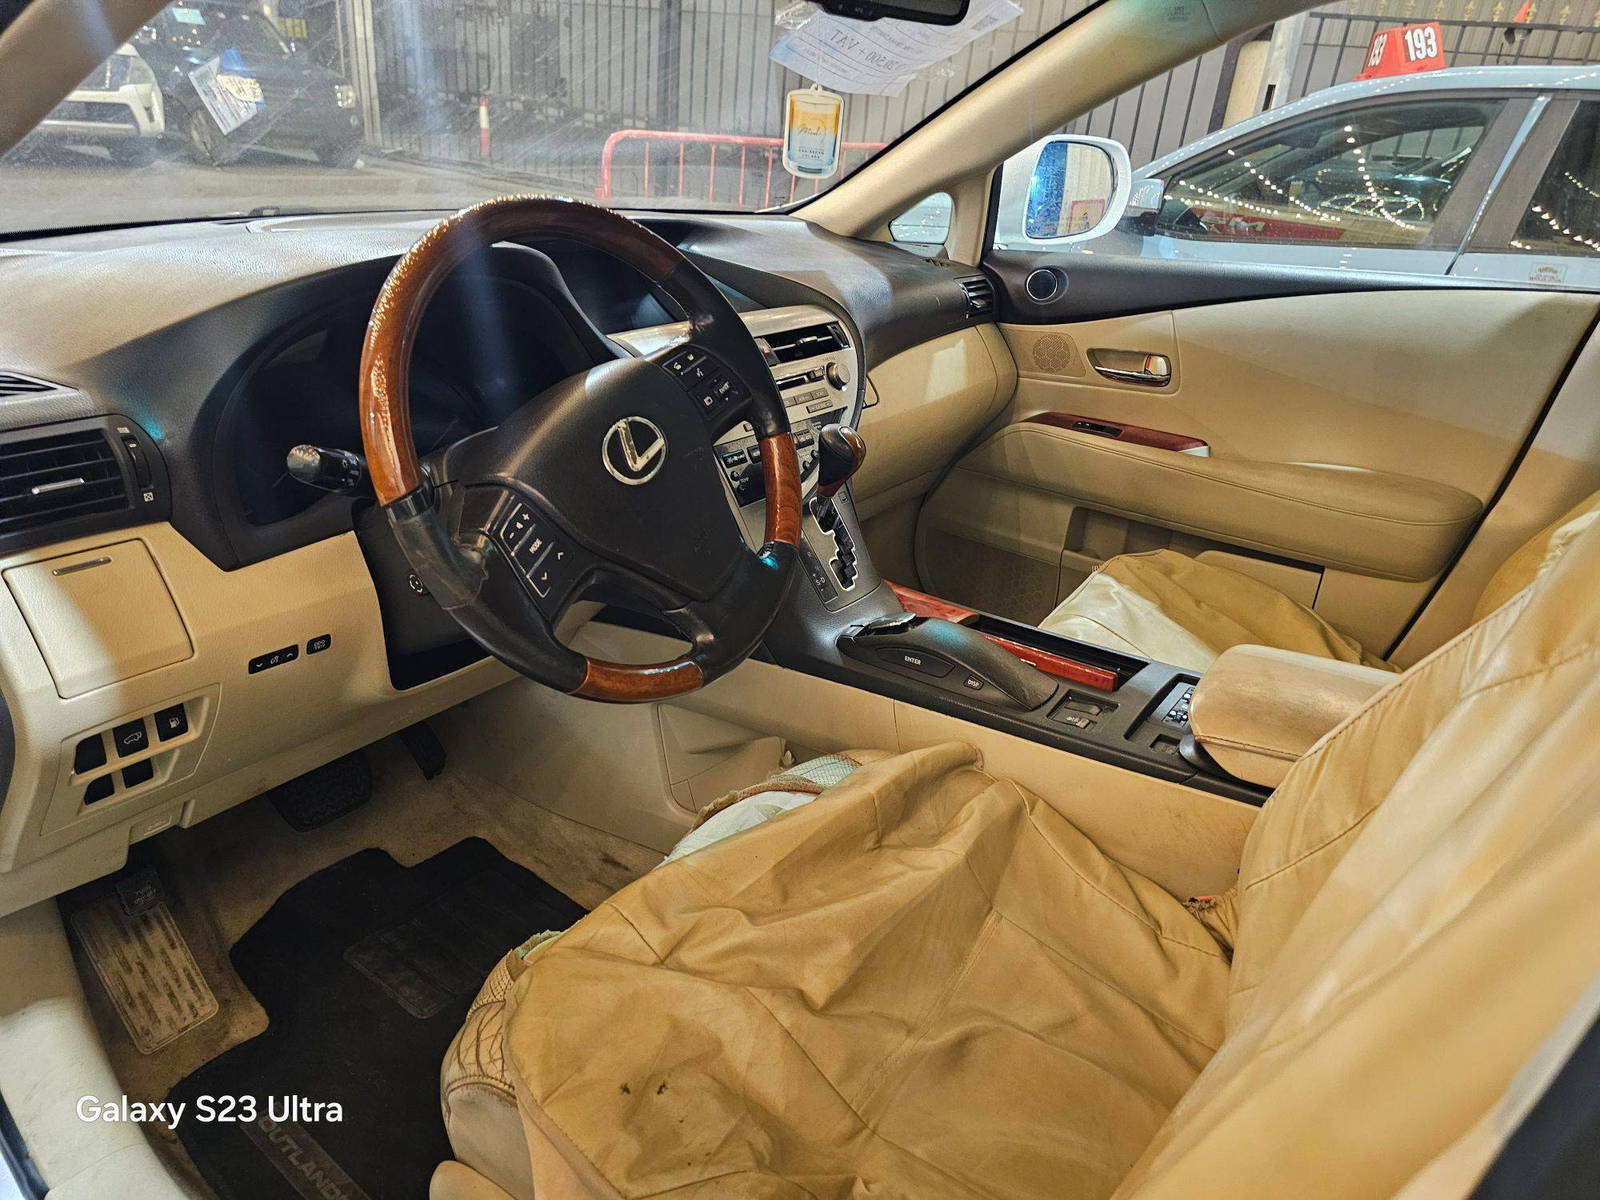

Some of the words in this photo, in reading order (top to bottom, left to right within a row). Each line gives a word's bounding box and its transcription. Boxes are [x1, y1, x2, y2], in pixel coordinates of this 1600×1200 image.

[1404, 26, 1438, 62] 193
[904, 655, 922, 666] ENTER
[967, 679, 980, 688] DISP
